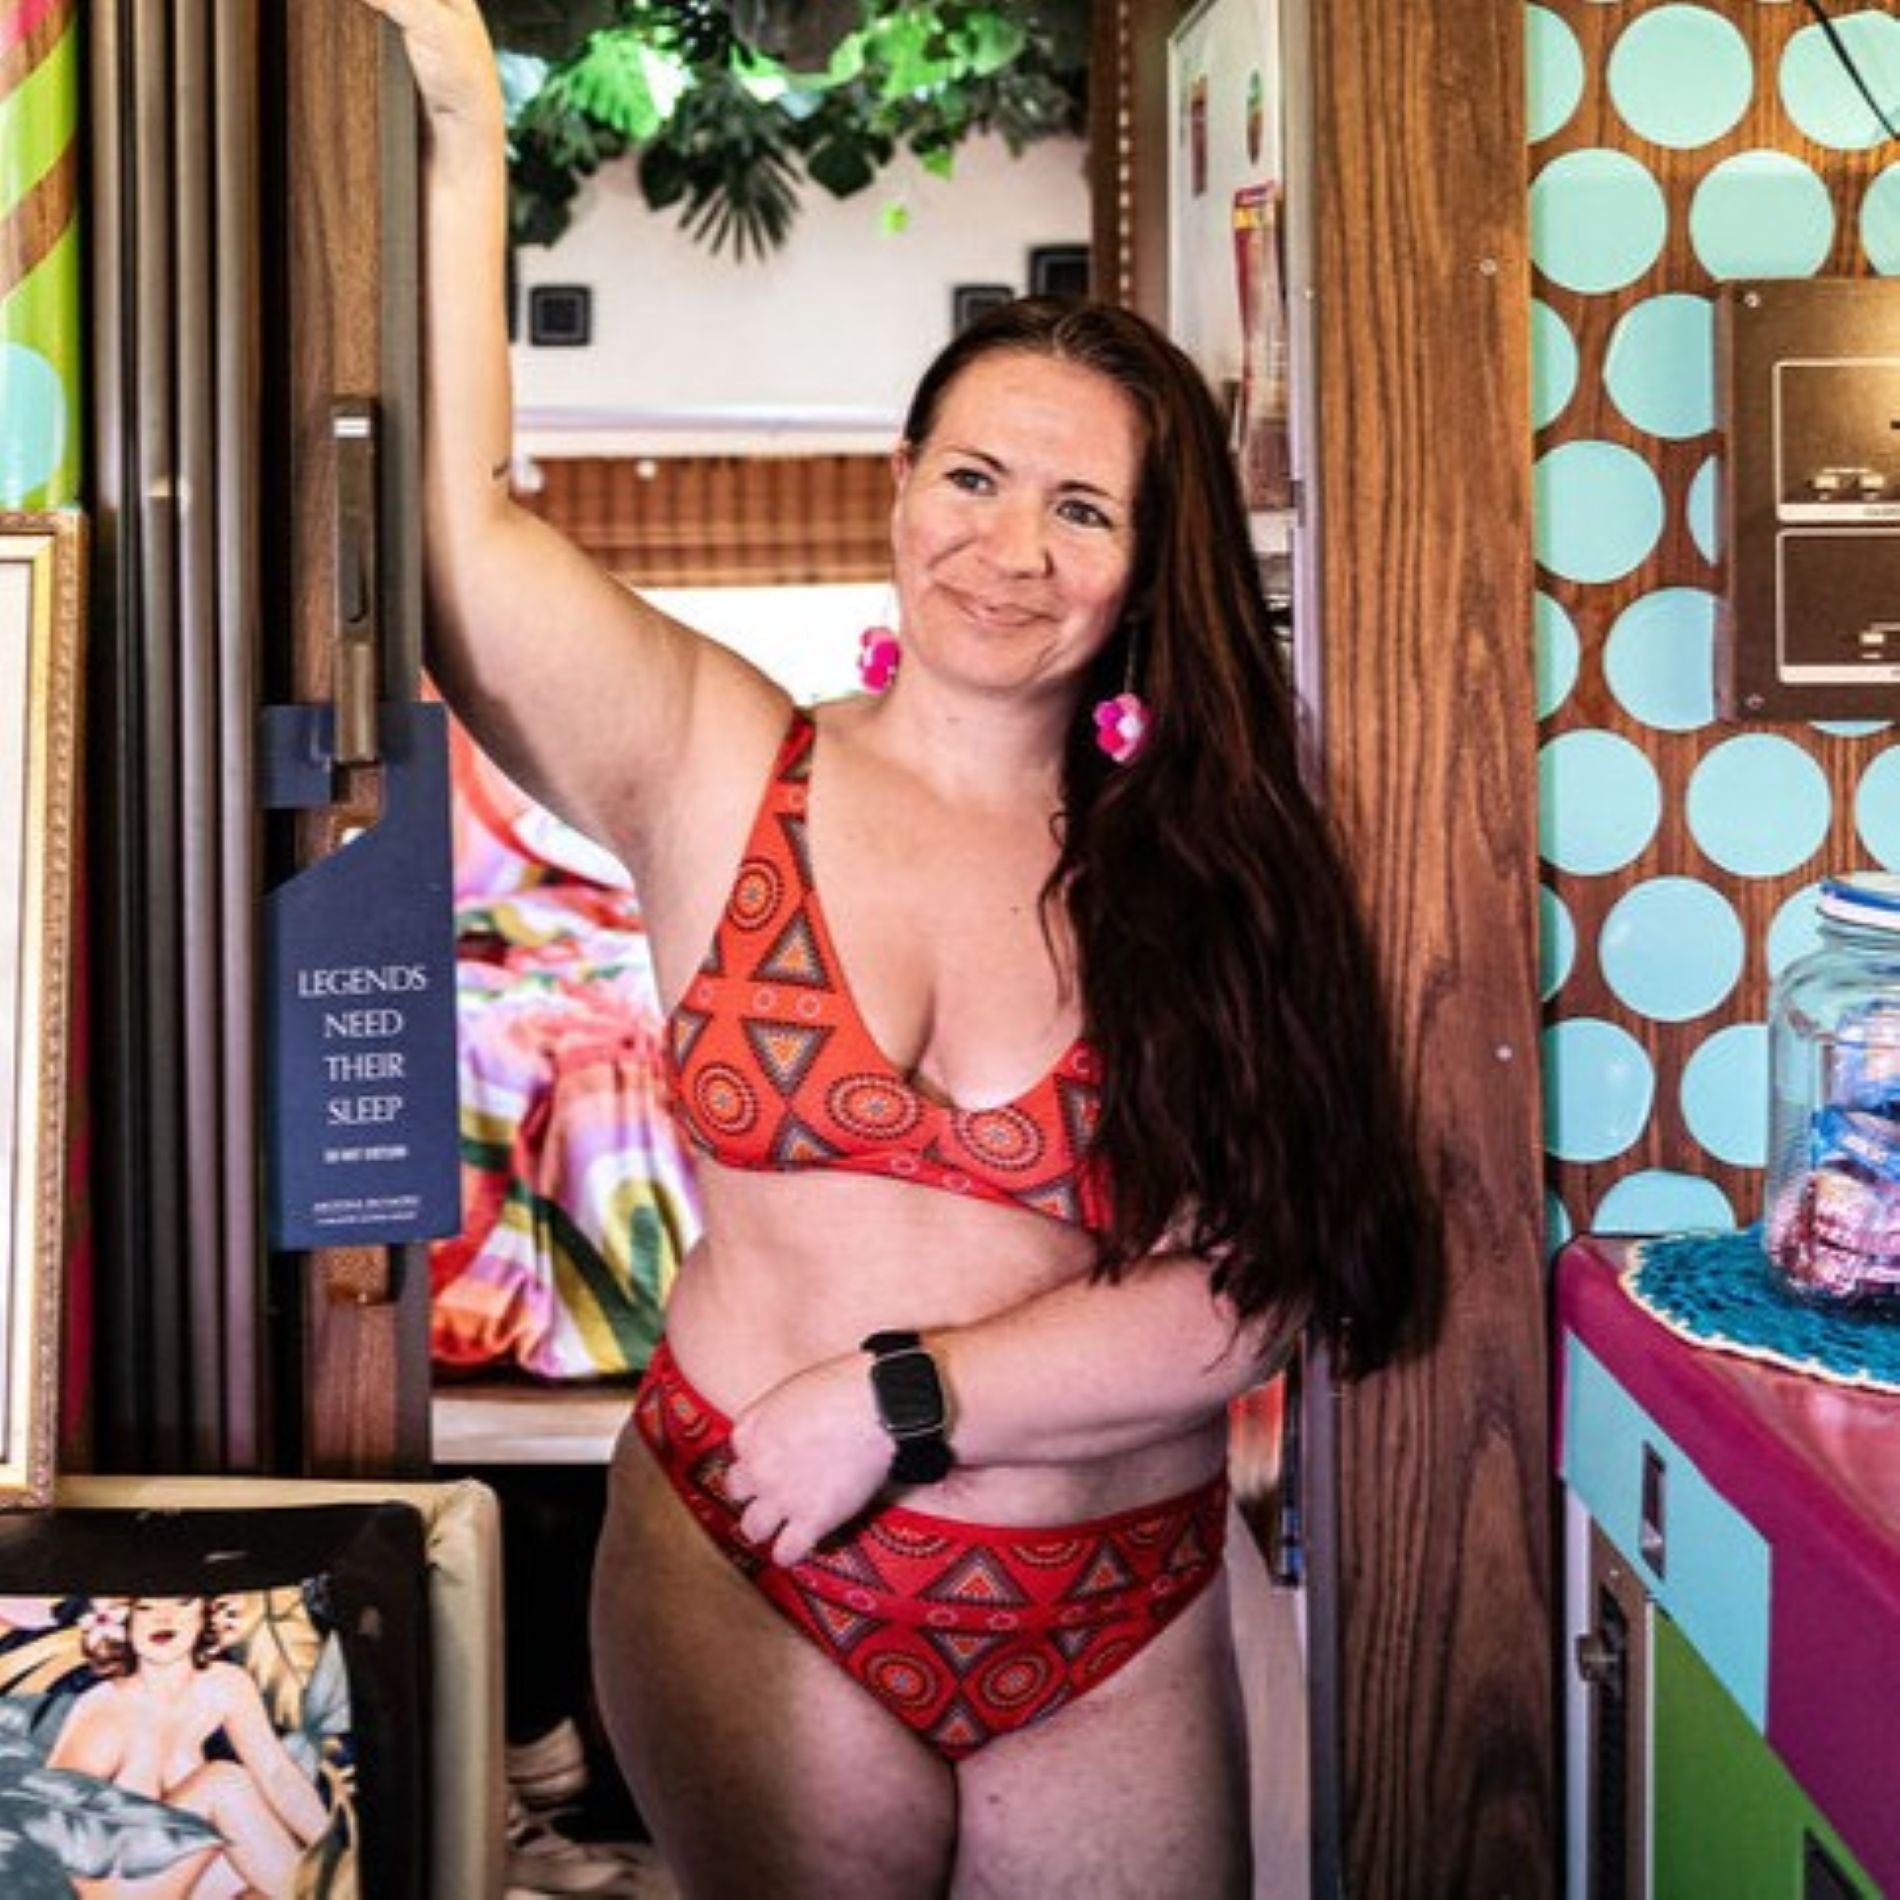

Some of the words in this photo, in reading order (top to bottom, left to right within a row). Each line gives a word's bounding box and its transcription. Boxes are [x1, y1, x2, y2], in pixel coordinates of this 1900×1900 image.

[298, 964, 429, 998] LEGENDS
[323, 1010, 404, 1039] NEED
[322, 1052, 405, 1082] THEIR
[327, 1096, 403, 1126] SLEEP
